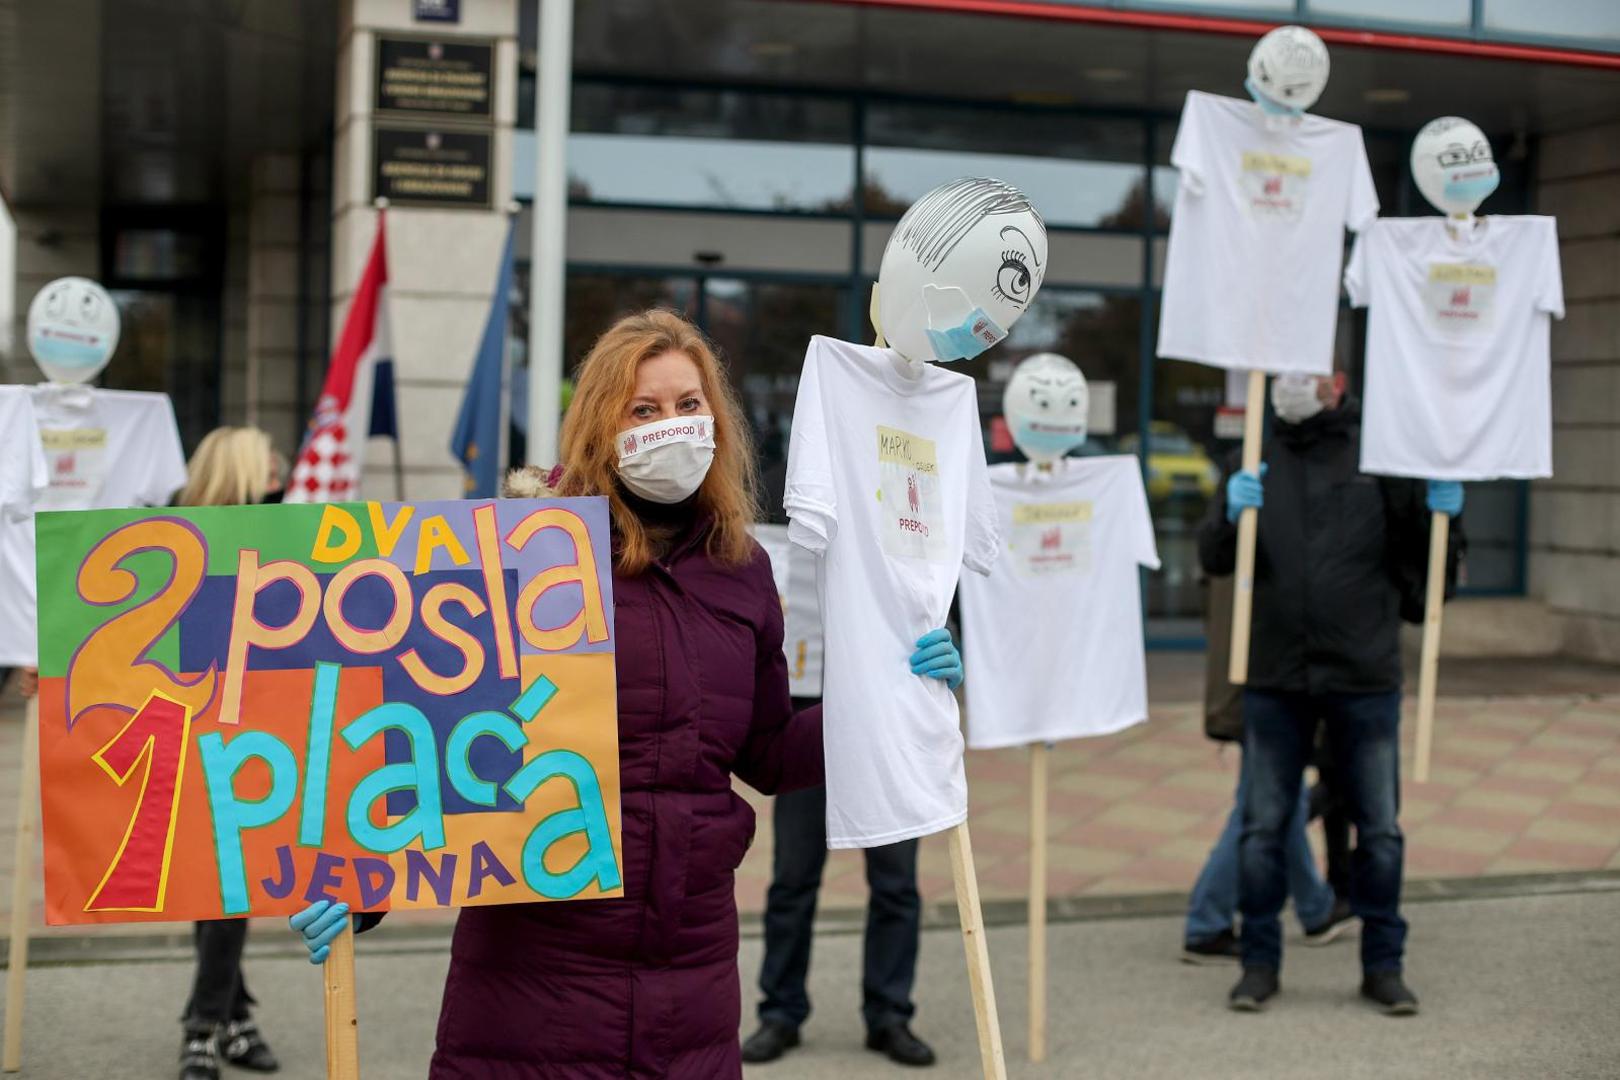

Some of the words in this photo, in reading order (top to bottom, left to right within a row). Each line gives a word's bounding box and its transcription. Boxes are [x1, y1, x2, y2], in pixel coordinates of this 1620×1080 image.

[642, 426, 695, 444] PREPOROD
[311, 501, 471, 575] DVA
[65, 516, 218, 733] 2
[218, 503, 610, 724] posla
[83, 688, 193, 913] 1
[198, 661, 622, 914] plaća
[261, 840, 517, 909] JEDNA
